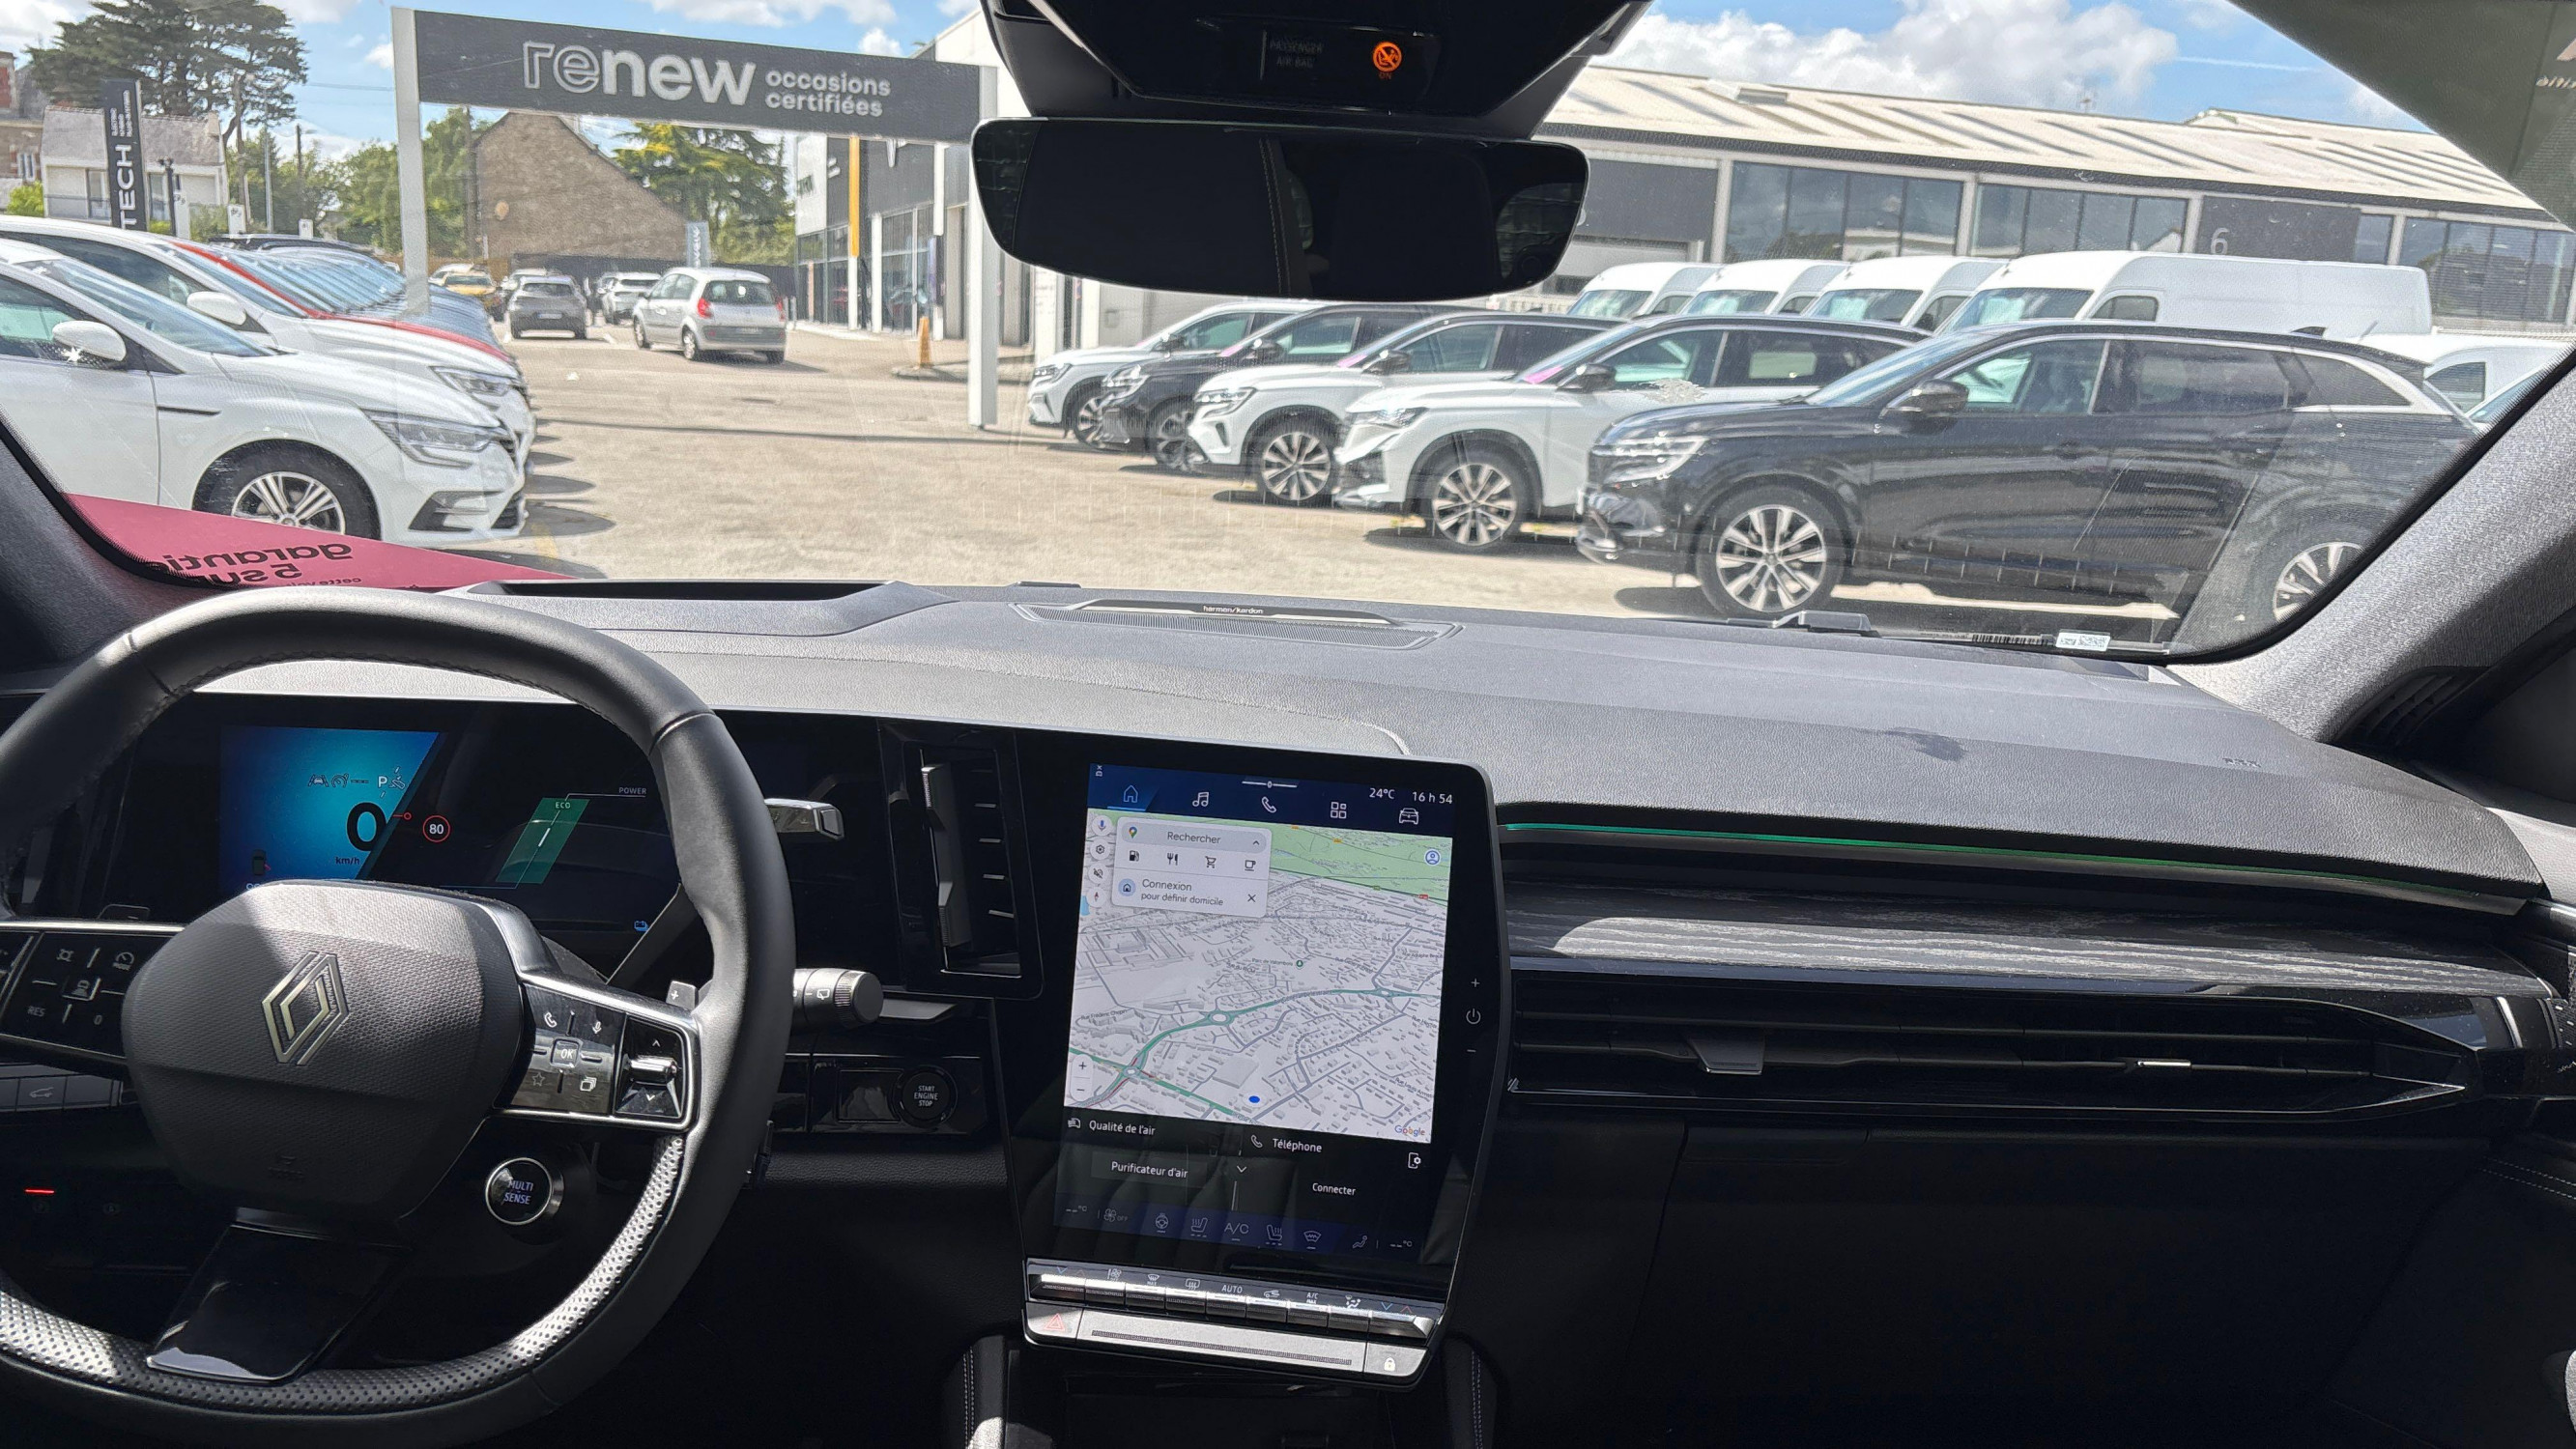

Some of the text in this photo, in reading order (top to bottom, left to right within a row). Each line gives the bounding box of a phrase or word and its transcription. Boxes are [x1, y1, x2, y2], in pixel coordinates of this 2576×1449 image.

[523, 41, 757, 105] renew
[765, 68, 891, 97] occasions
[765, 91, 883, 117] certifiées
[2211, 227, 2229, 255] 6
[1203, 605, 1265, 614] harman/kardon
[1368, 787, 1395, 800] 24°C
[1412, 791, 1453, 805] 16 h 54
[555, 801, 571, 810] ECO
[346, 802, 387, 852] 0
[429, 824, 444, 836] 80
[1167, 831, 1221, 844] Rechercher
[335, 856, 360, 866] km/h
[1142, 878, 1192, 892] Connexion
[1140, 893, 1223, 906] pour définir domicile
[27, 1006, 46, 1017] RES
[560, 1048, 574, 1060] OK
[914, 1092, 938, 1100] ENGINE
[1089, 1120, 1156, 1136] Qualité de l'air
[1394, 1124, 1426, 1137] Google
[1273, 1138, 1323, 1153] Téléphone
[1111, 1161, 1188, 1179] Purificateur d'air
[508, 1180, 534, 1191] MULTI
[1312, 1182, 1356, 1196] Connecter
[503, 1192, 531, 1205] SENSE
[1224, 1222, 1249, 1235] A/C
[1221, 1284, 1244, 1294] AUTO
[1306, 1292, 1319, 1300] A/C
